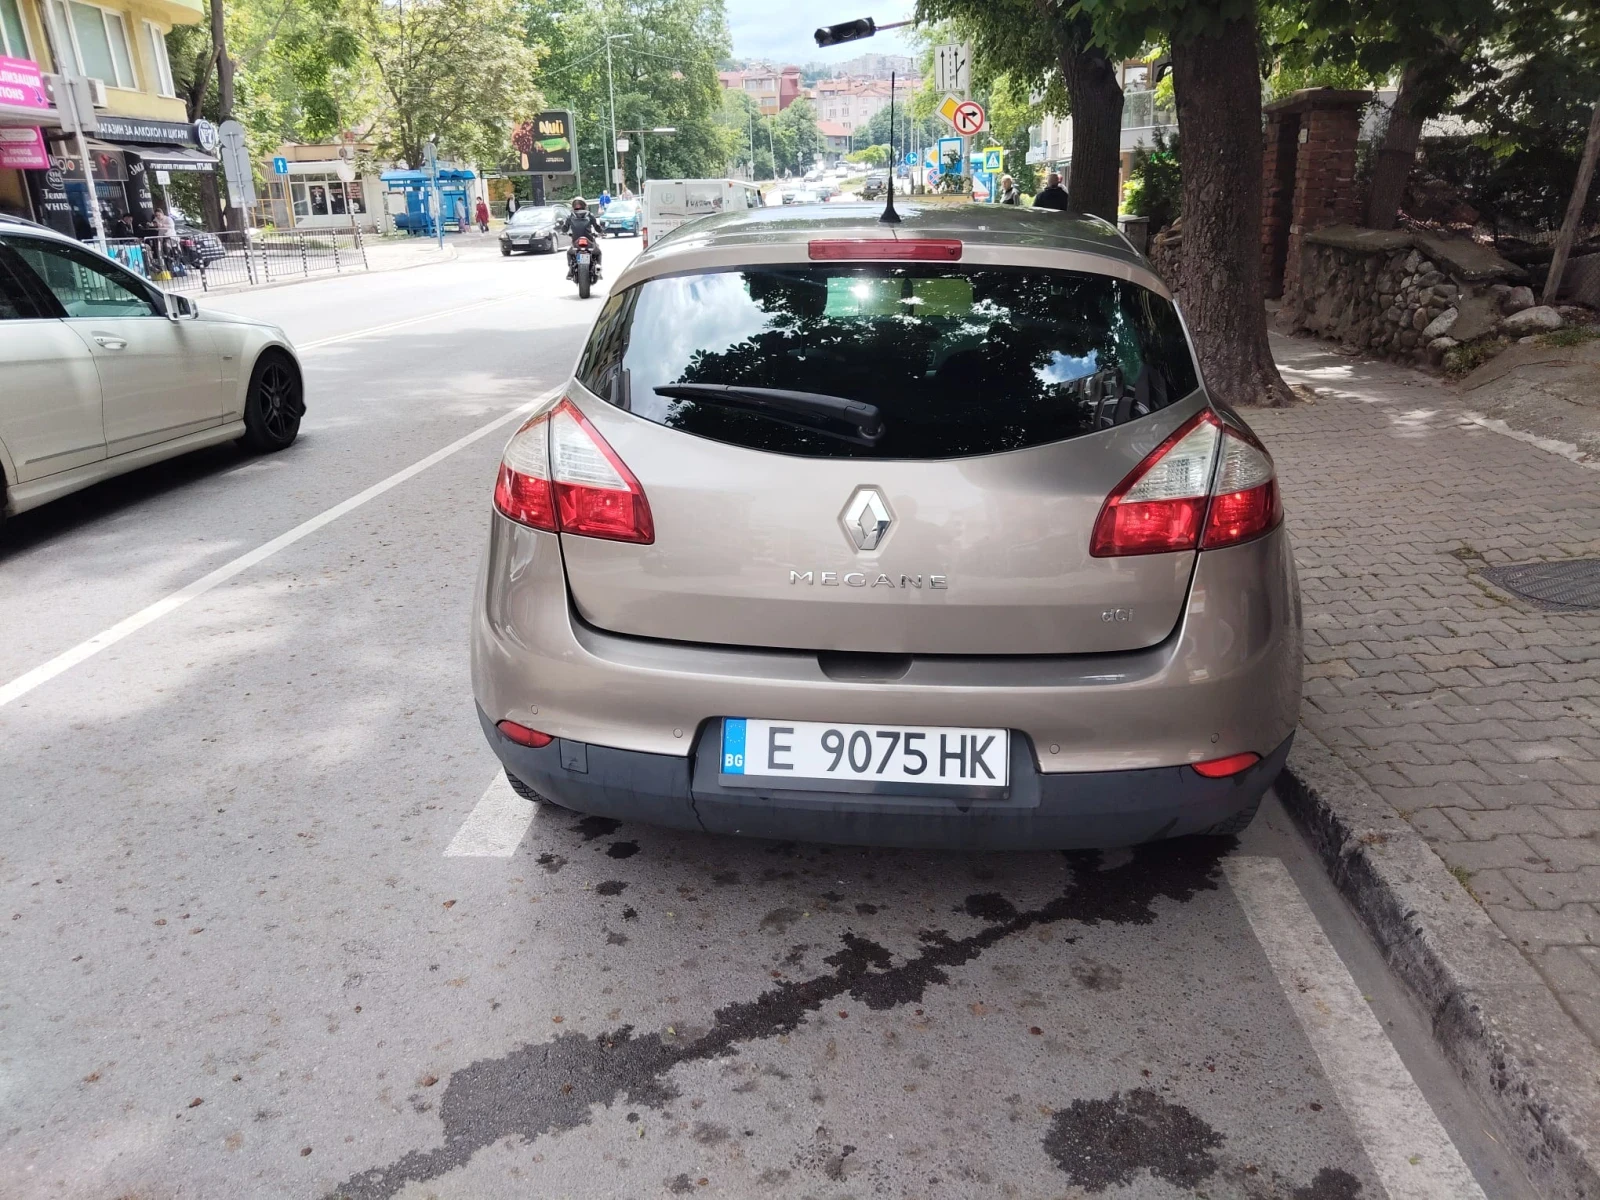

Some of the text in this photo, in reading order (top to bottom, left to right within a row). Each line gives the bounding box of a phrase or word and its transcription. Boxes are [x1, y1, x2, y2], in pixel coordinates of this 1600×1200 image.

[124, 124, 134, 136] ЗА
[134, 126, 163, 138] АЛКОХОЛ
[168, 128, 190, 140] ЦИГАРИ
[789, 570, 949, 590] MEGANE
[724, 753, 743, 768] BG
[767, 726, 996, 780] E 9075 HK
